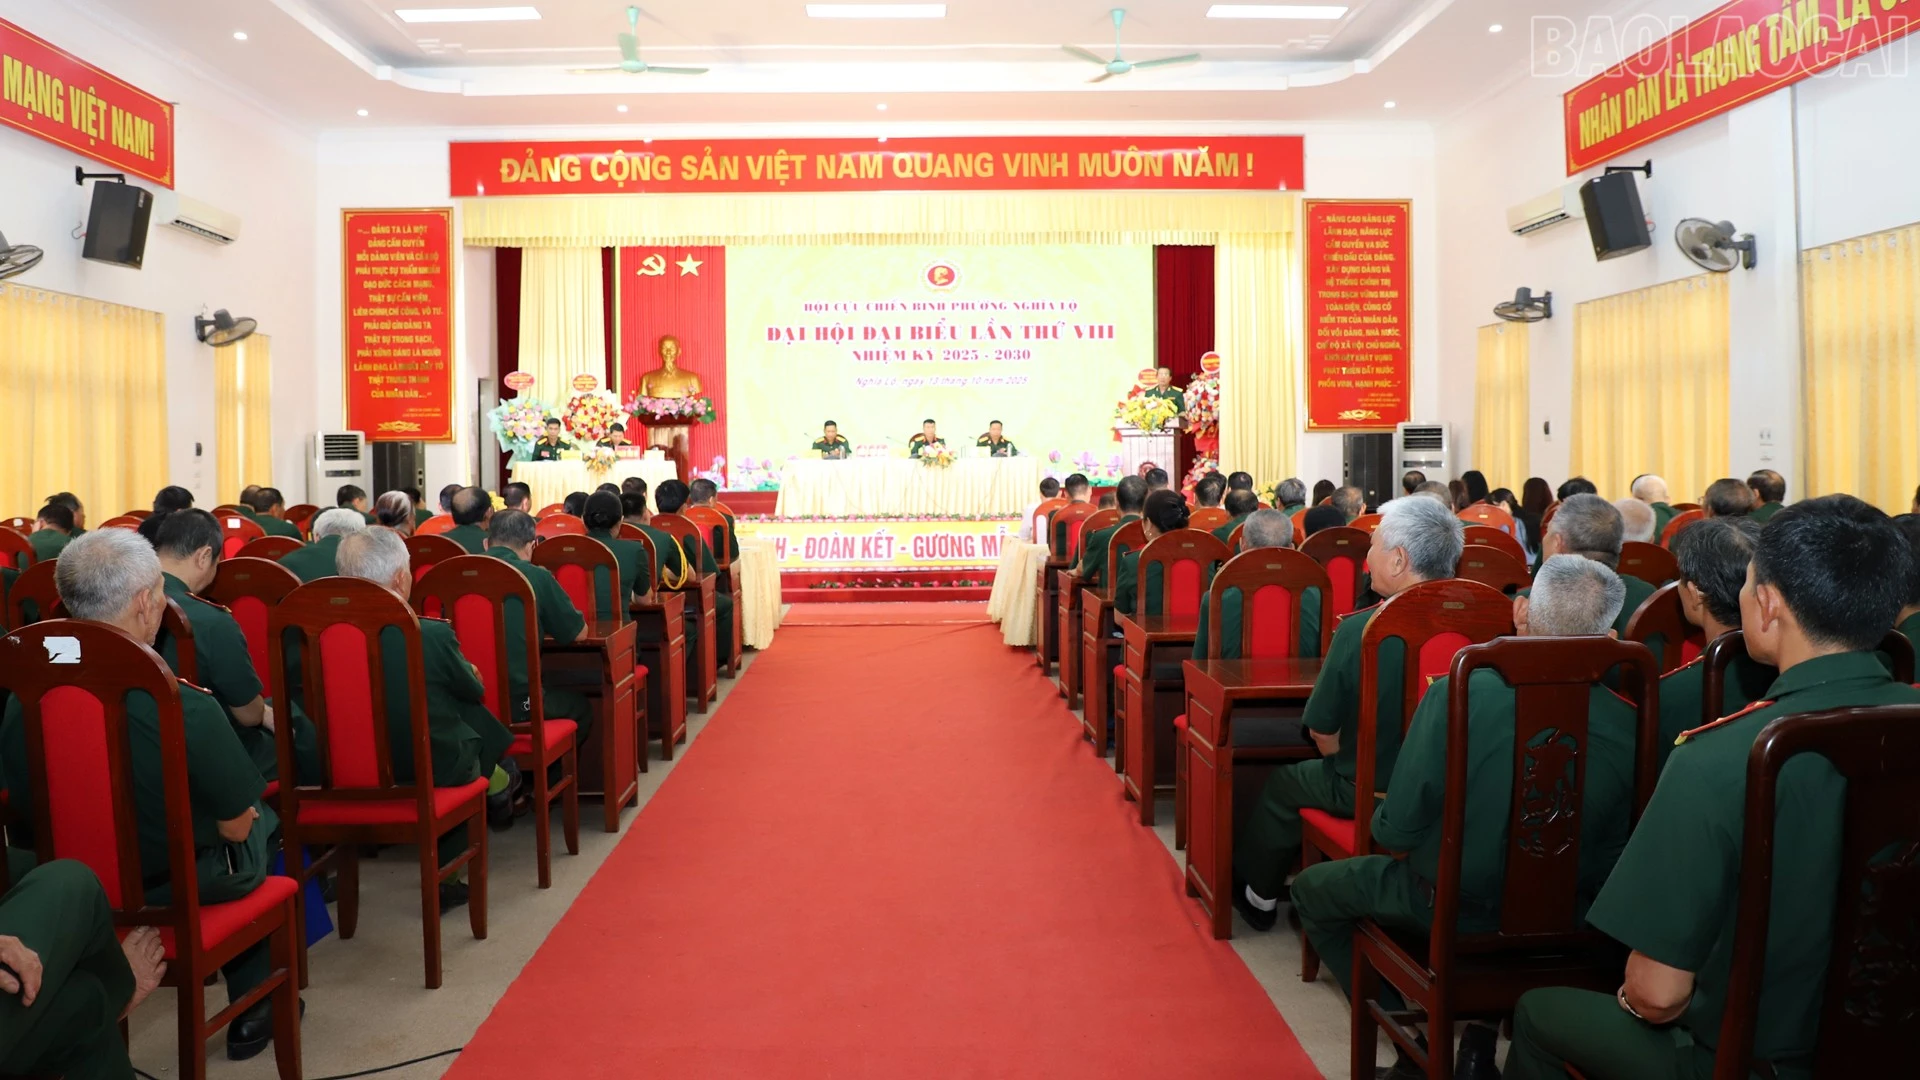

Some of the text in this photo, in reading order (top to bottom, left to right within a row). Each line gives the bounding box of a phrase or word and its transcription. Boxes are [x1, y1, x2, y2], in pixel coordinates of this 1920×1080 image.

[1579, 92, 1622, 151] NHÂN
[1624, 73, 1660, 130] DÂN
[1664, 52, 1689, 112] LÀ
[1692, 24, 1761, 98] TRUNG
[1766, 0, 1829, 64] TÂM,
[3, 54, 155, 161] MẠNG VIỆT NAM!
[500, 145, 1254, 188] ĐẢNG CỘNG SẢN VIỆT NAM QUANG VINH MUÔN NĂM !
[1347, 215, 1360, 223] CAO
[392, 225, 401, 234] TA
[804, 300, 1078, 313] HỘI CỰU CHIẾN BINH PHƯỜNG NGHĨA LỘ
[423, 321, 432, 329] TA
[767, 317, 1114, 345] ĐẠI HỘI ĐẠI BIỂU LẦN THỨ VIII
[853, 347, 905, 364] NHIỆM
[943, 349, 979, 361] 2025
[995, 349, 1031, 361] 2030
[1006, 376, 1028, 385] 2025
[805, 530, 855, 559] ĐOÀN
[861, 528, 894, 558] KẾT
[913, 534, 975, 558] GƯƠNG
